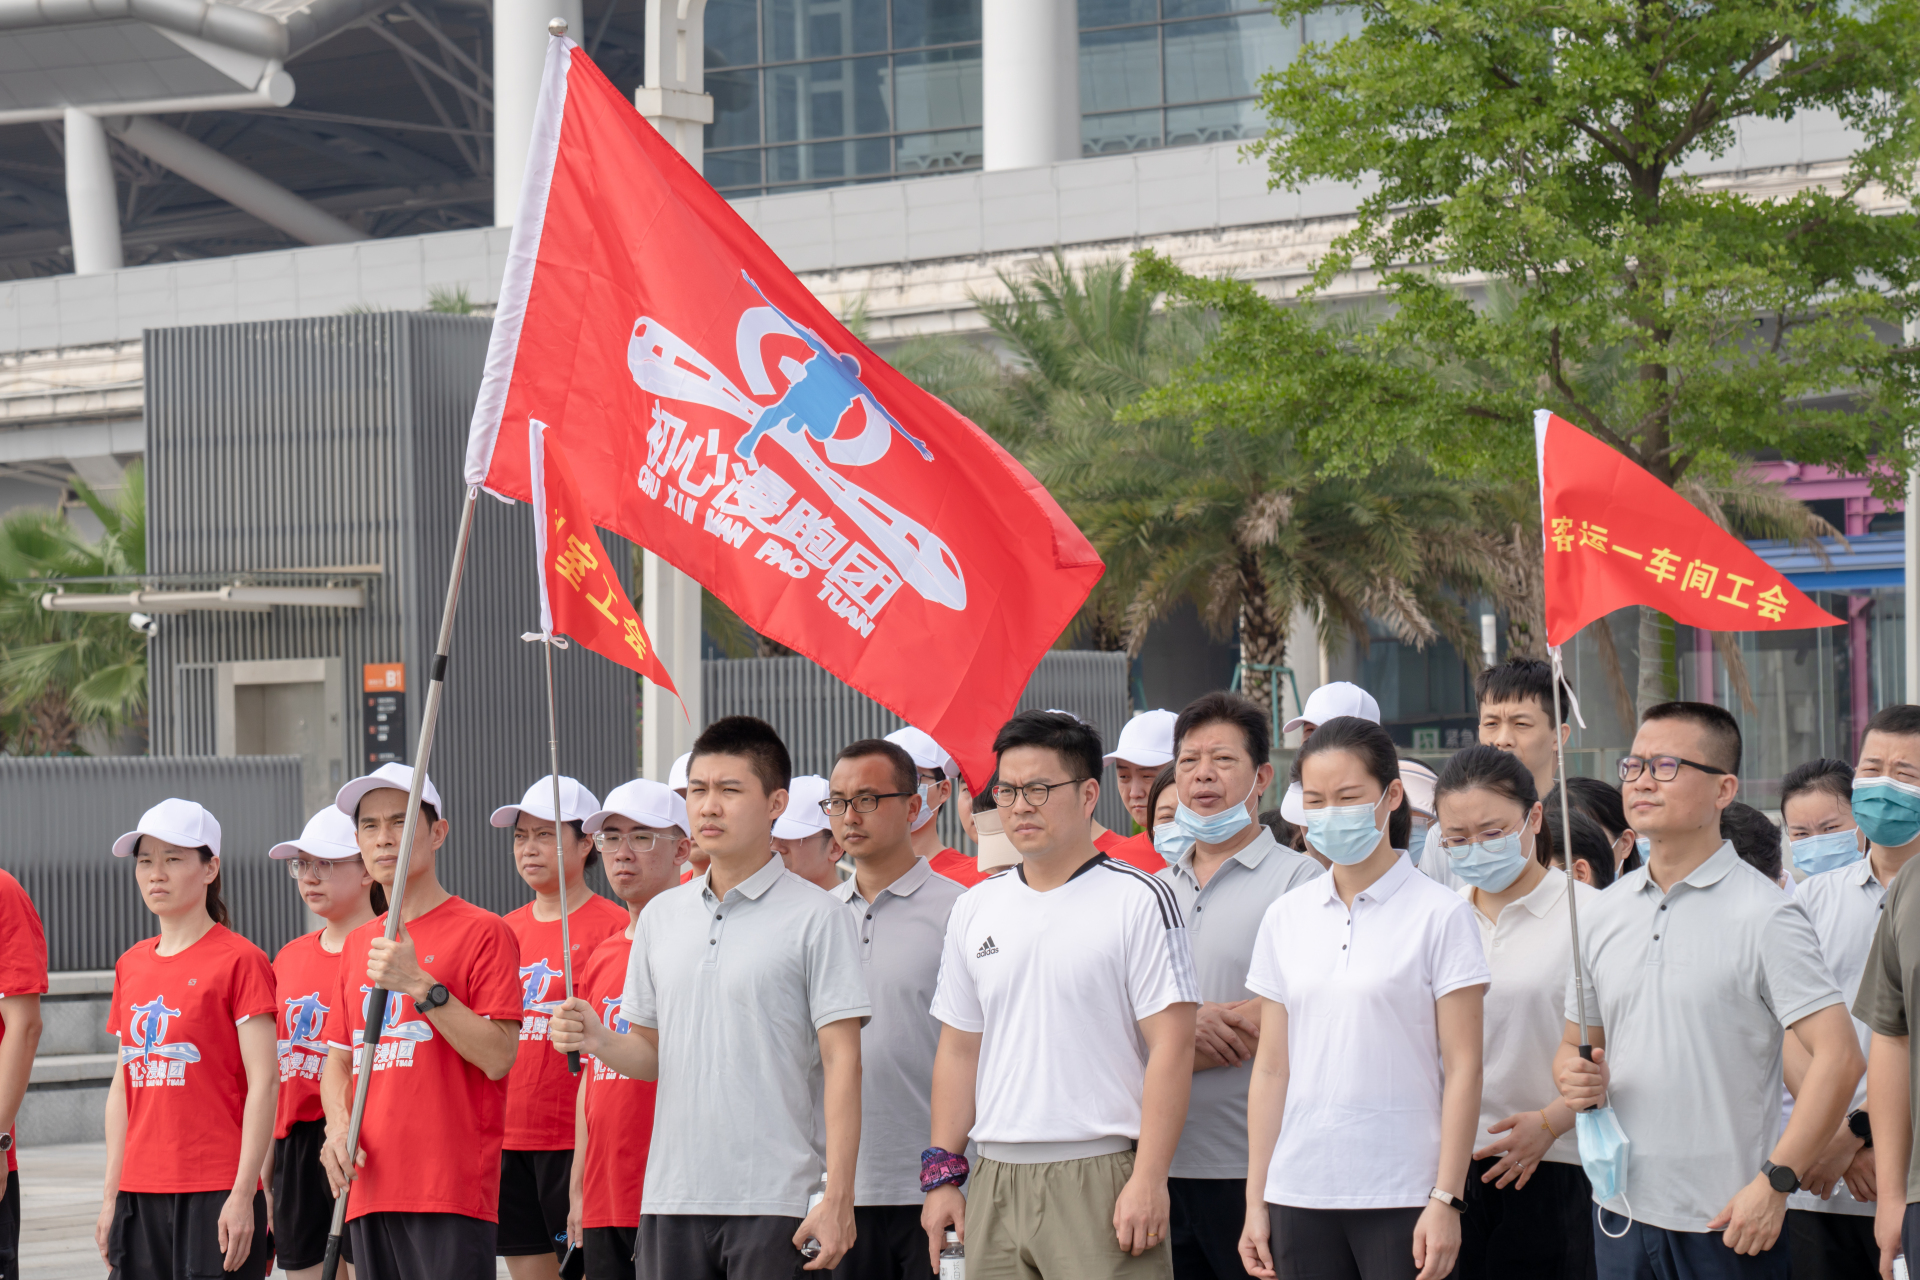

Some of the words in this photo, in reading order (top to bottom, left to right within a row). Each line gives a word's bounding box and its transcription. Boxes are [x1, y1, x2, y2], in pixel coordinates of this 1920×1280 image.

[637, 464, 661, 500] CHU
[663, 484, 698, 525] XIN
[703, 507, 754, 550] WAN
[753, 538, 810, 579] PAO
[816, 578, 876, 639] TUAN
[646, 398, 904, 620] 初心漫跑团
[1550, 515, 1790, 623] 客运一车间工会
[1445, 728, 1479, 748] 紧急
[976, 947, 999, 959] adidas
